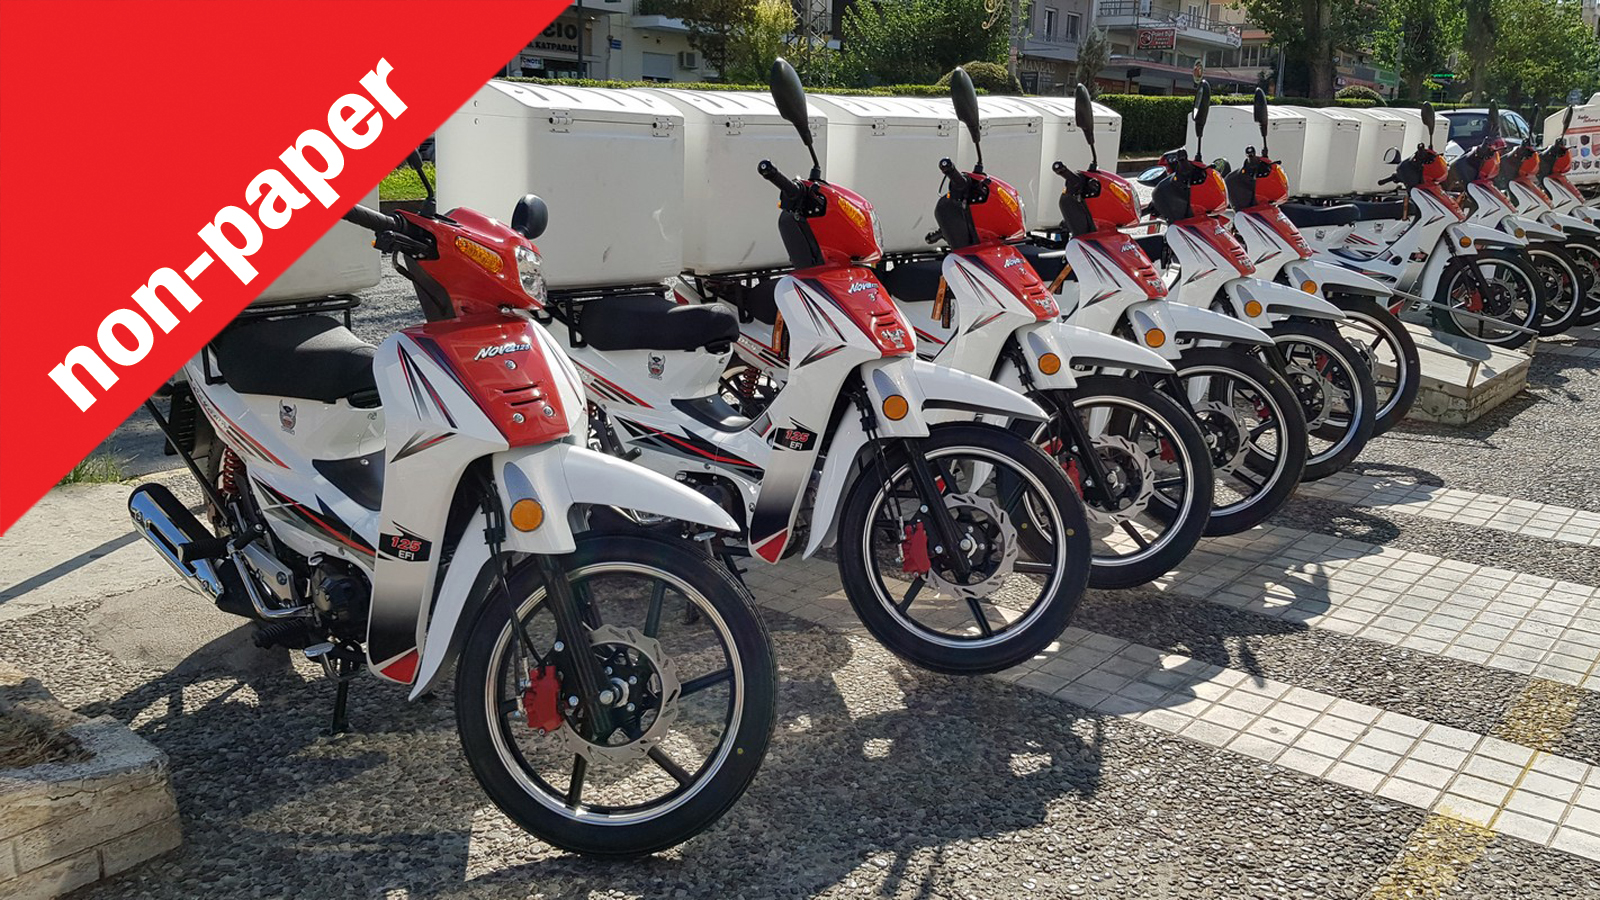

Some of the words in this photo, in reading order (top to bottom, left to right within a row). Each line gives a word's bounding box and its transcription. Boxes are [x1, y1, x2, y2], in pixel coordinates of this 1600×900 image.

[785, 429, 809, 442] 125
[790, 441, 802, 450] EFI
[391, 536, 422, 552] 125
[398, 550, 415, 561] EFI
